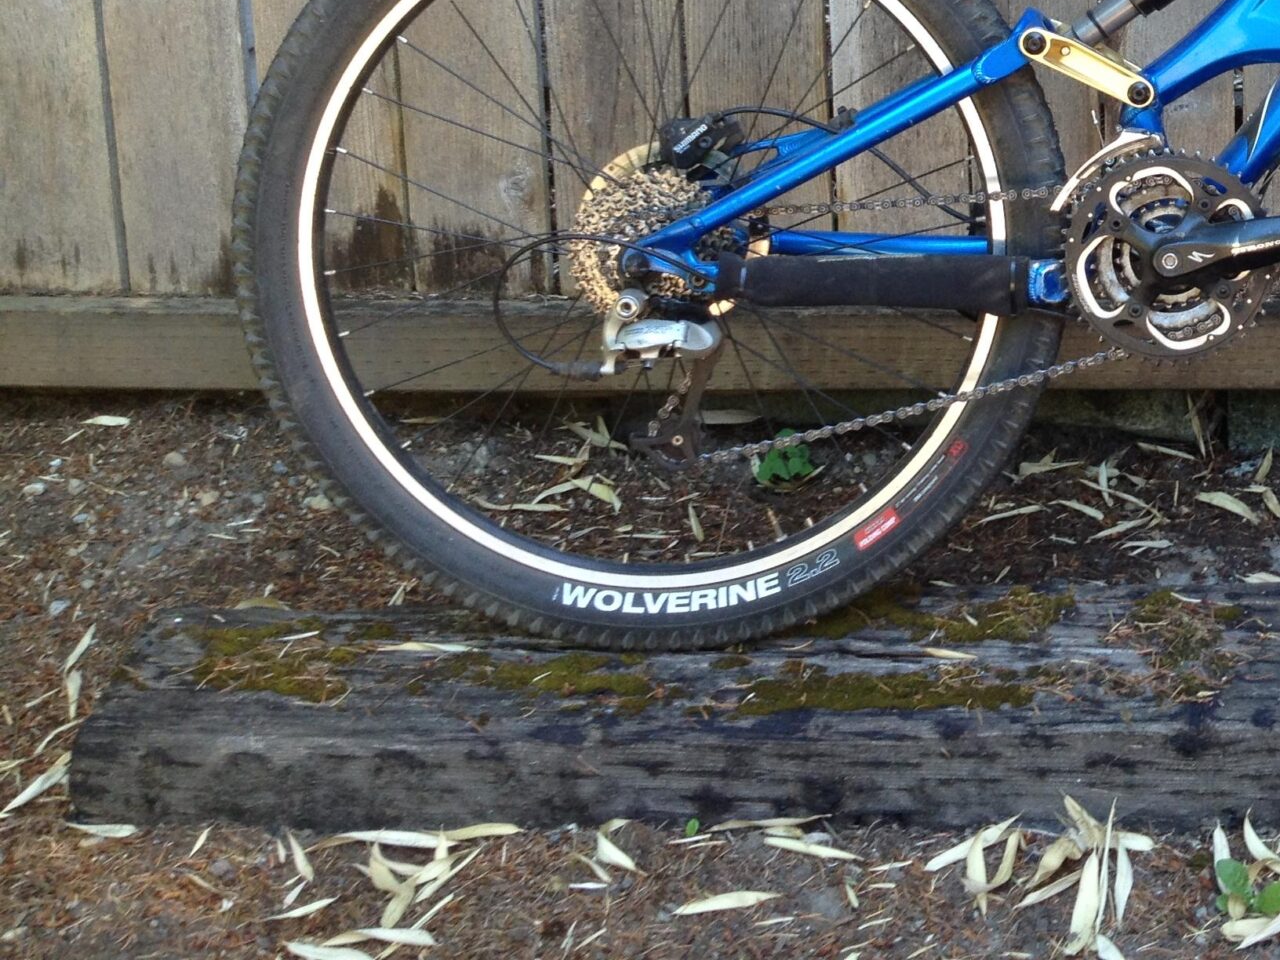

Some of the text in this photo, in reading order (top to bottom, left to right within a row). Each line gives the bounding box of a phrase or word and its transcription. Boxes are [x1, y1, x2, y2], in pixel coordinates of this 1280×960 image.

[673, 124, 708, 153] SHIMANO
[562, 547, 841, 615] WOLVERINE 2.2
